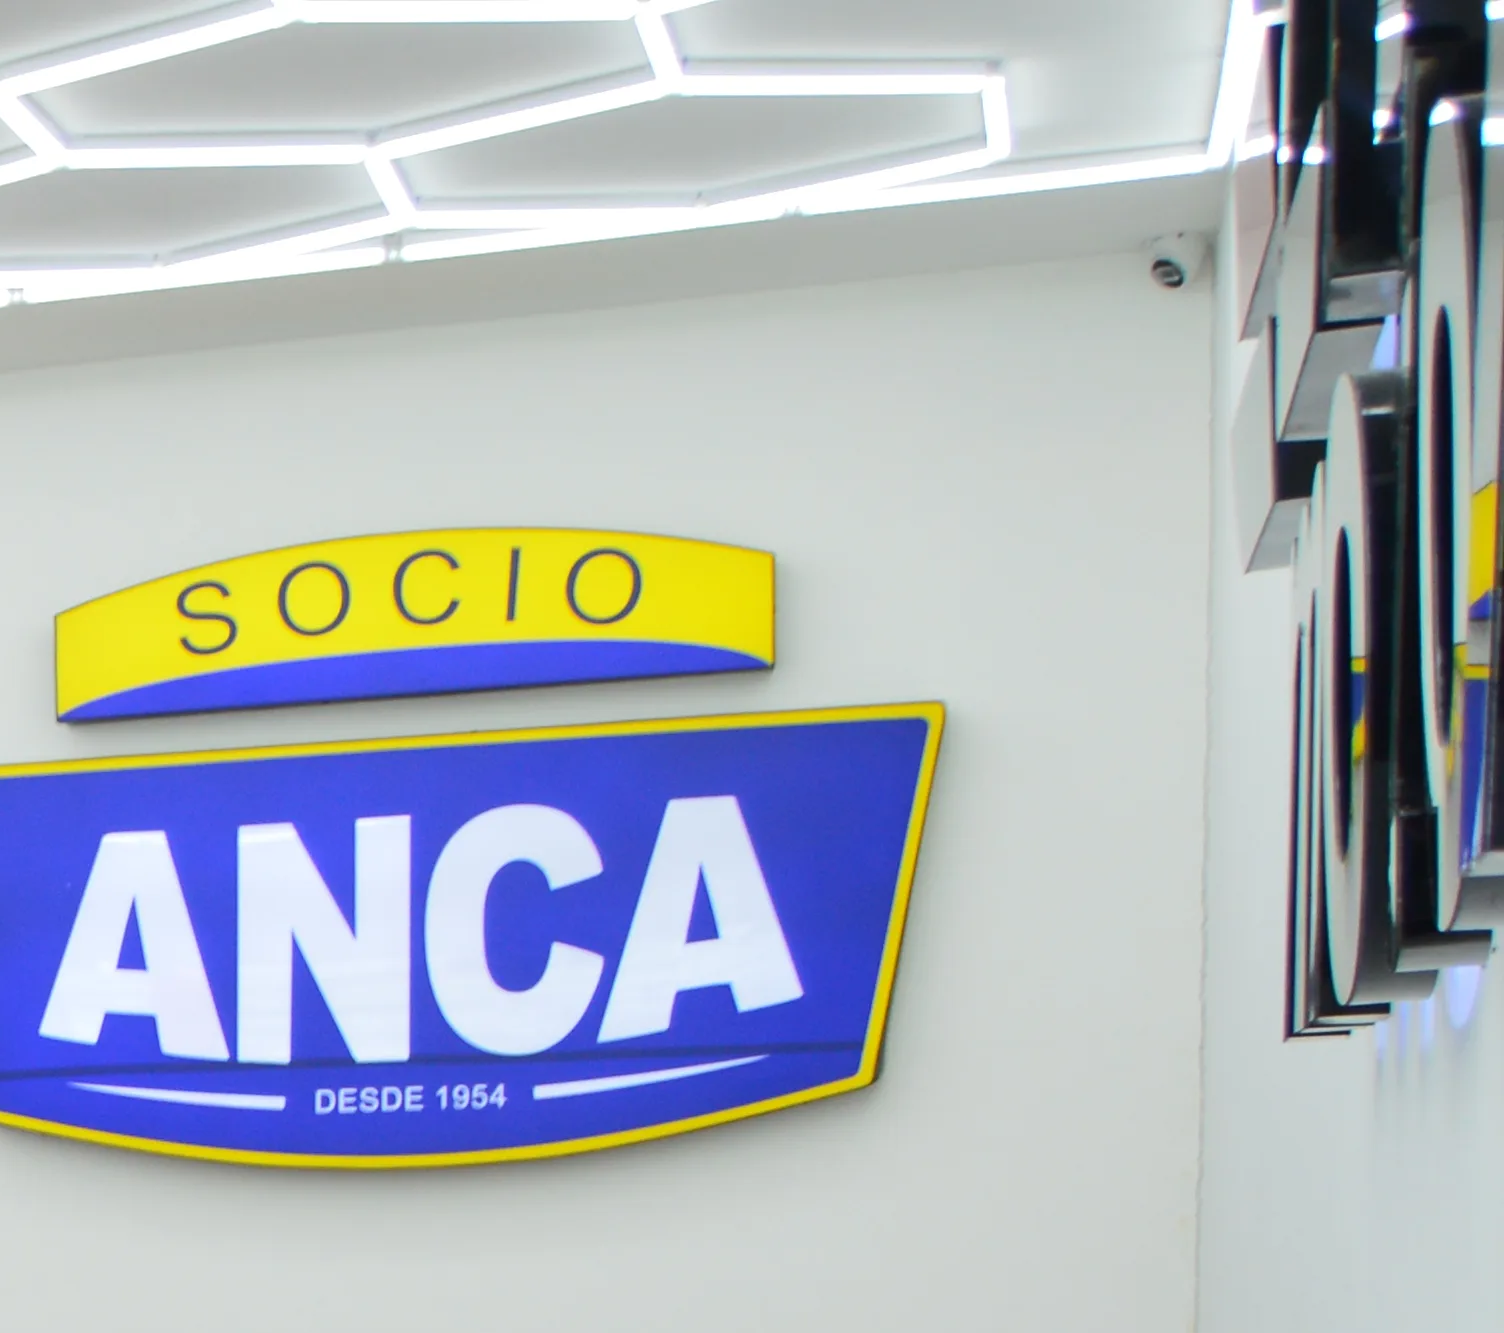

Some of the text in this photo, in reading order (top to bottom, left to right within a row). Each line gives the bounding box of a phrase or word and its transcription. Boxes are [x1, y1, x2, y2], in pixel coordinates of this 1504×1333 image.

[176, 547, 644, 656] SOCIO
[39, 795, 804, 1064] ANCA
[315, 1083, 507, 1113] DESDE 1954
